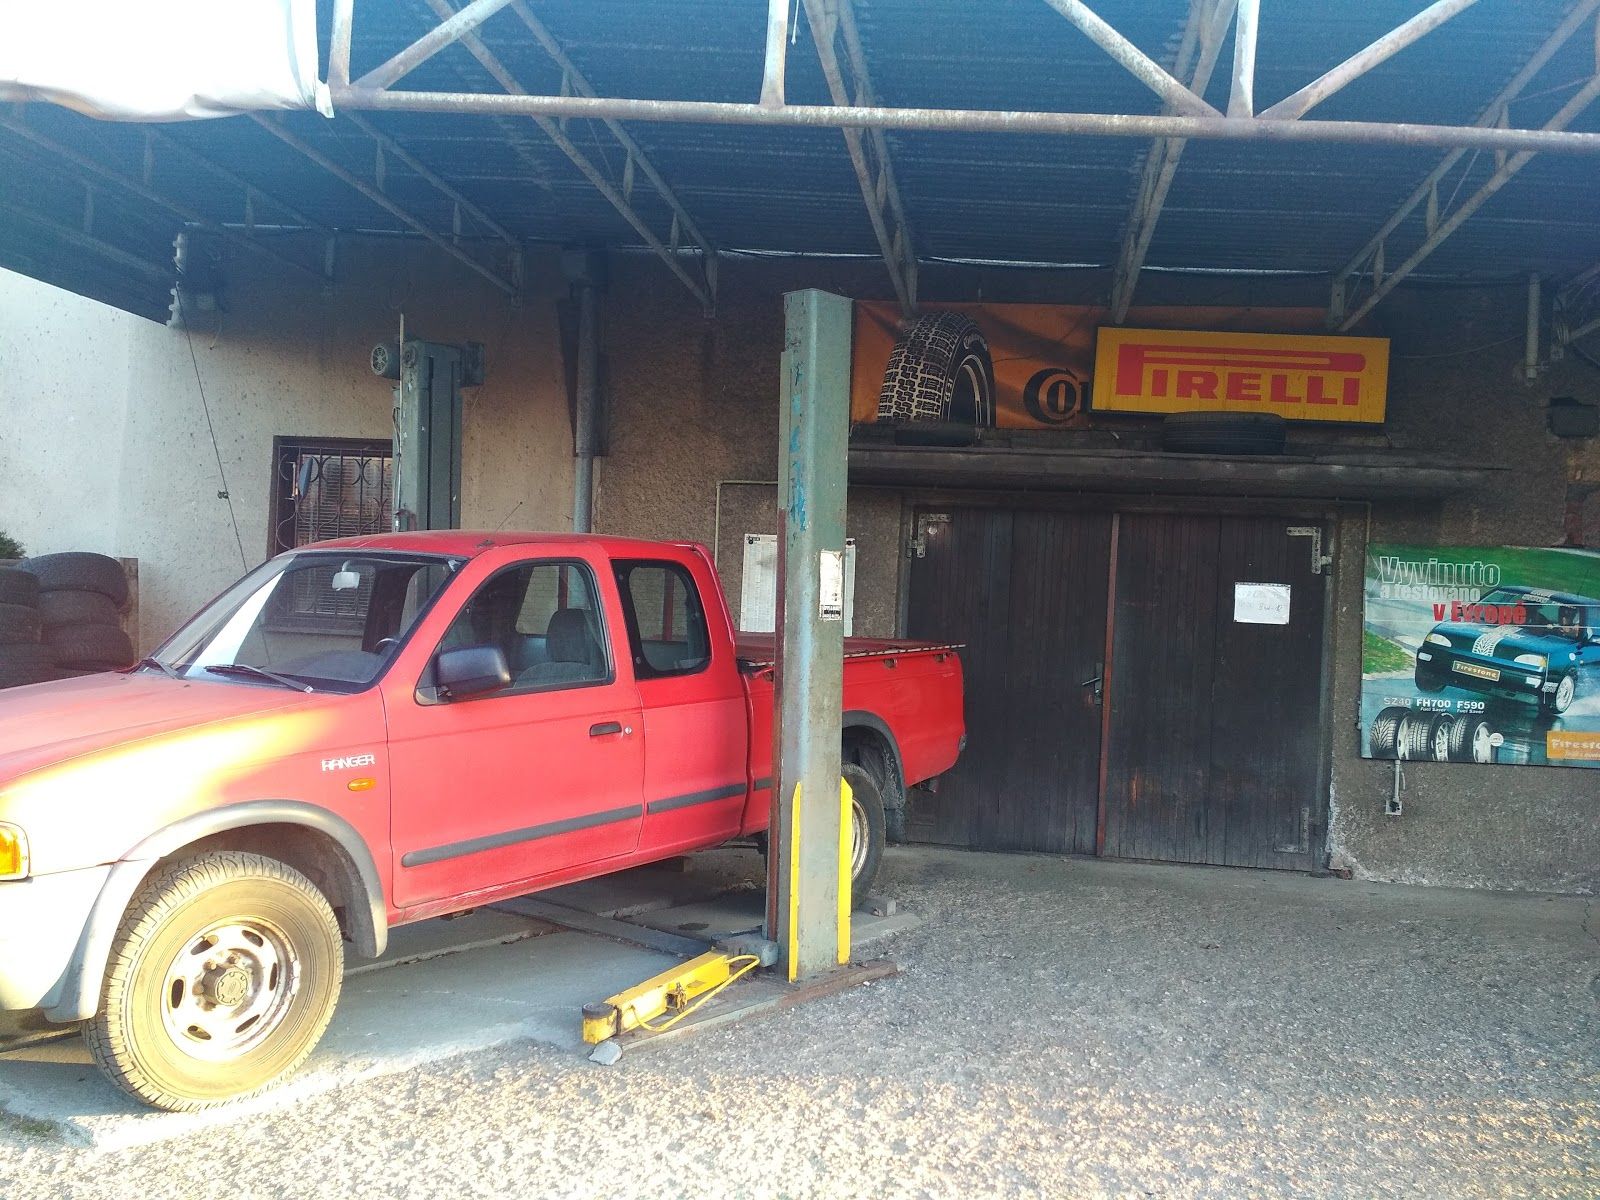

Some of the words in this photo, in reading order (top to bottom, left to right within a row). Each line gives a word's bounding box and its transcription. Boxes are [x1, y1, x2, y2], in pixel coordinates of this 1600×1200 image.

[1116, 343, 1366, 406] PIRELLI
[1380, 556, 1500, 587] Vyvinuto
[1380, 585, 1390, 599] a
[1394, 584, 1481, 602] testováno
[1433, 604, 1446, 621] v
[1451, 600, 1527, 626] Evropě
[1456, 663, 1497, 679] Firestone
[1416, 698, 1451, 708] FH700
[1457, 700, 1485, 710] F590
[321, 754, 376, 772] RANGER
